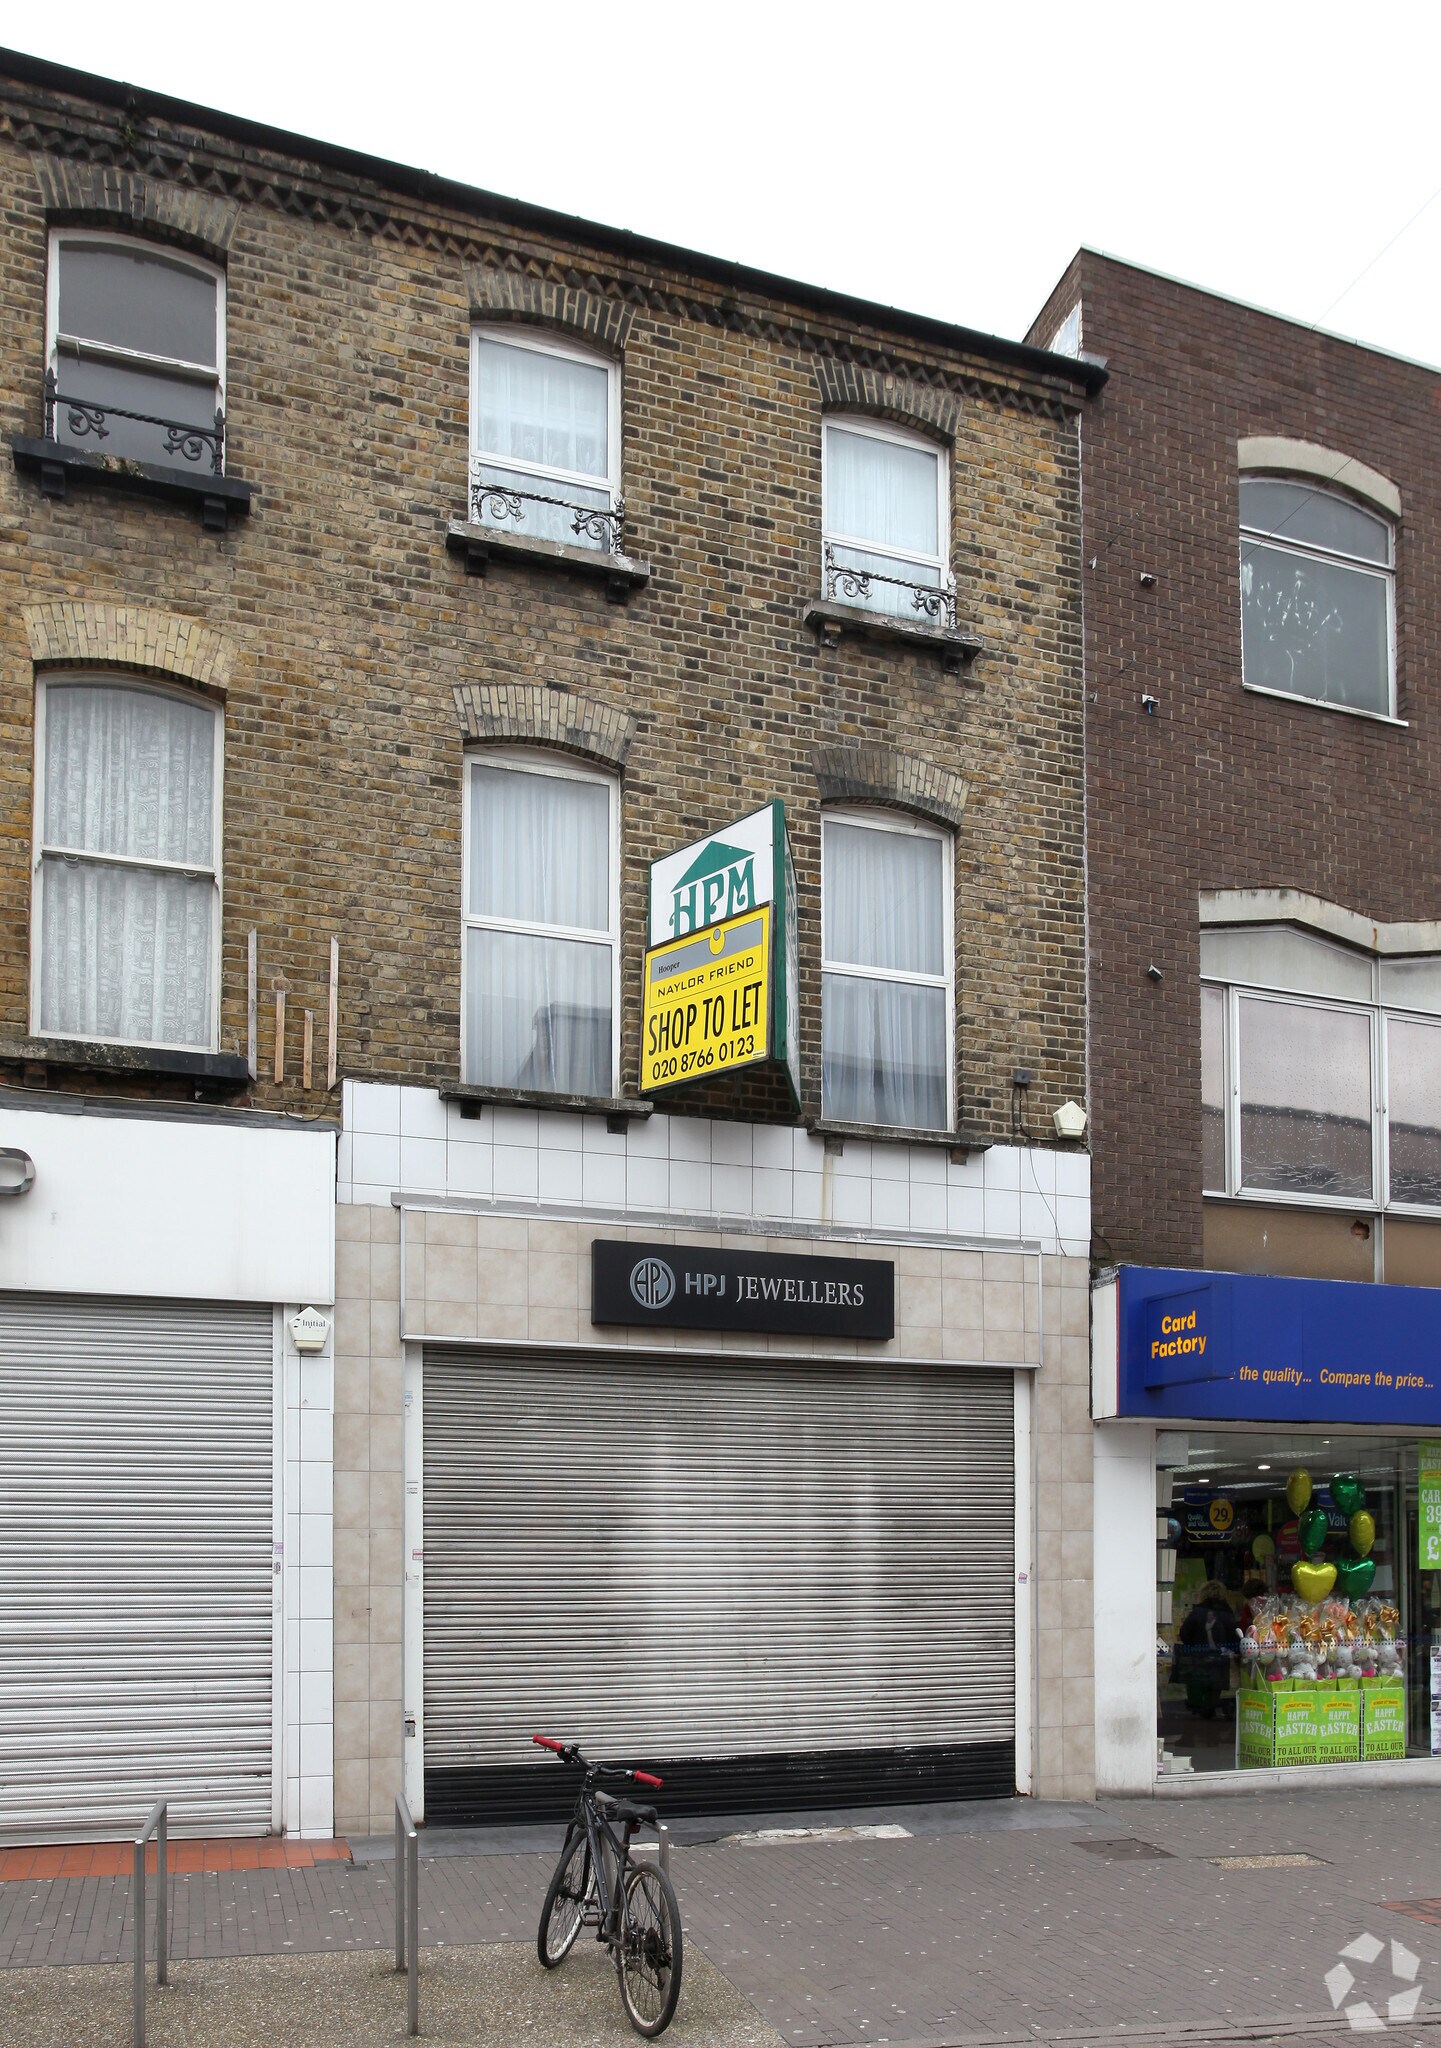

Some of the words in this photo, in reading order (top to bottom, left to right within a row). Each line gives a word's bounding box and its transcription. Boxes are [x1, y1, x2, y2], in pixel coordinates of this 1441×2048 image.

[668, 857, 757, 938] HPM
[658, 961, 680, 974] Hooper
[658, 974, 705, 998] NAYLOR
[709, 957, 754, 981] FRIEND
[648, 1003, 698, 1056] SHOP
[703, 995, 725, 1040] TO
[732, 981, 763, 1032] LET
[652, 1057, 678, 1080] 020
[681, 1047, 714, 1073] 8766
[719, 1034, 754, 1062] 0123
[685, 1272, 726, 1297] HPJ
[736, 1275, 865, 1307] JEWELLERS
[302, 1319, 326, 1328] Initial
[1161, 1310, 1196, 1335] Card
[1151, 1336, 1207, 1359] Factory
[1239, 1365, 1259, 1381] the
[1262, 1367, 1312, 1386] quality...
[1320, 1368, 1371, 1388] Compare
[1374, 1371, 1393, 1387] the
[1395, 1373, 1434, 1390] price...
[1287, 1710, 1309, 1721] HAPPY
[1328, 1710, 1350, 1721] HAPPY
[1375, 1707, 1396, 1718] HAPPY
[1277, 1722, 1318, 1739] EASTER
[1320, 1721, 1358, 1737] EASTER
[1366, 1719, 1404, 1735] EASTER
[1277, 1747, 1287, 1756] TO
[1288, 1746, 1301, 1755] ALL
[1303, 1745, 1317, 1754] OUR
[1319, 1746, 1328, 1755] TO
[1330, 1746, 1342, 1754] ALL
[1344, 1745, 1357, 1754] OUR
[1366, 1743, 1375, 1752] TO
[1376, 1742, 1388, 1751] ALL
[1391, 1741, 1404, 1750] OUR
